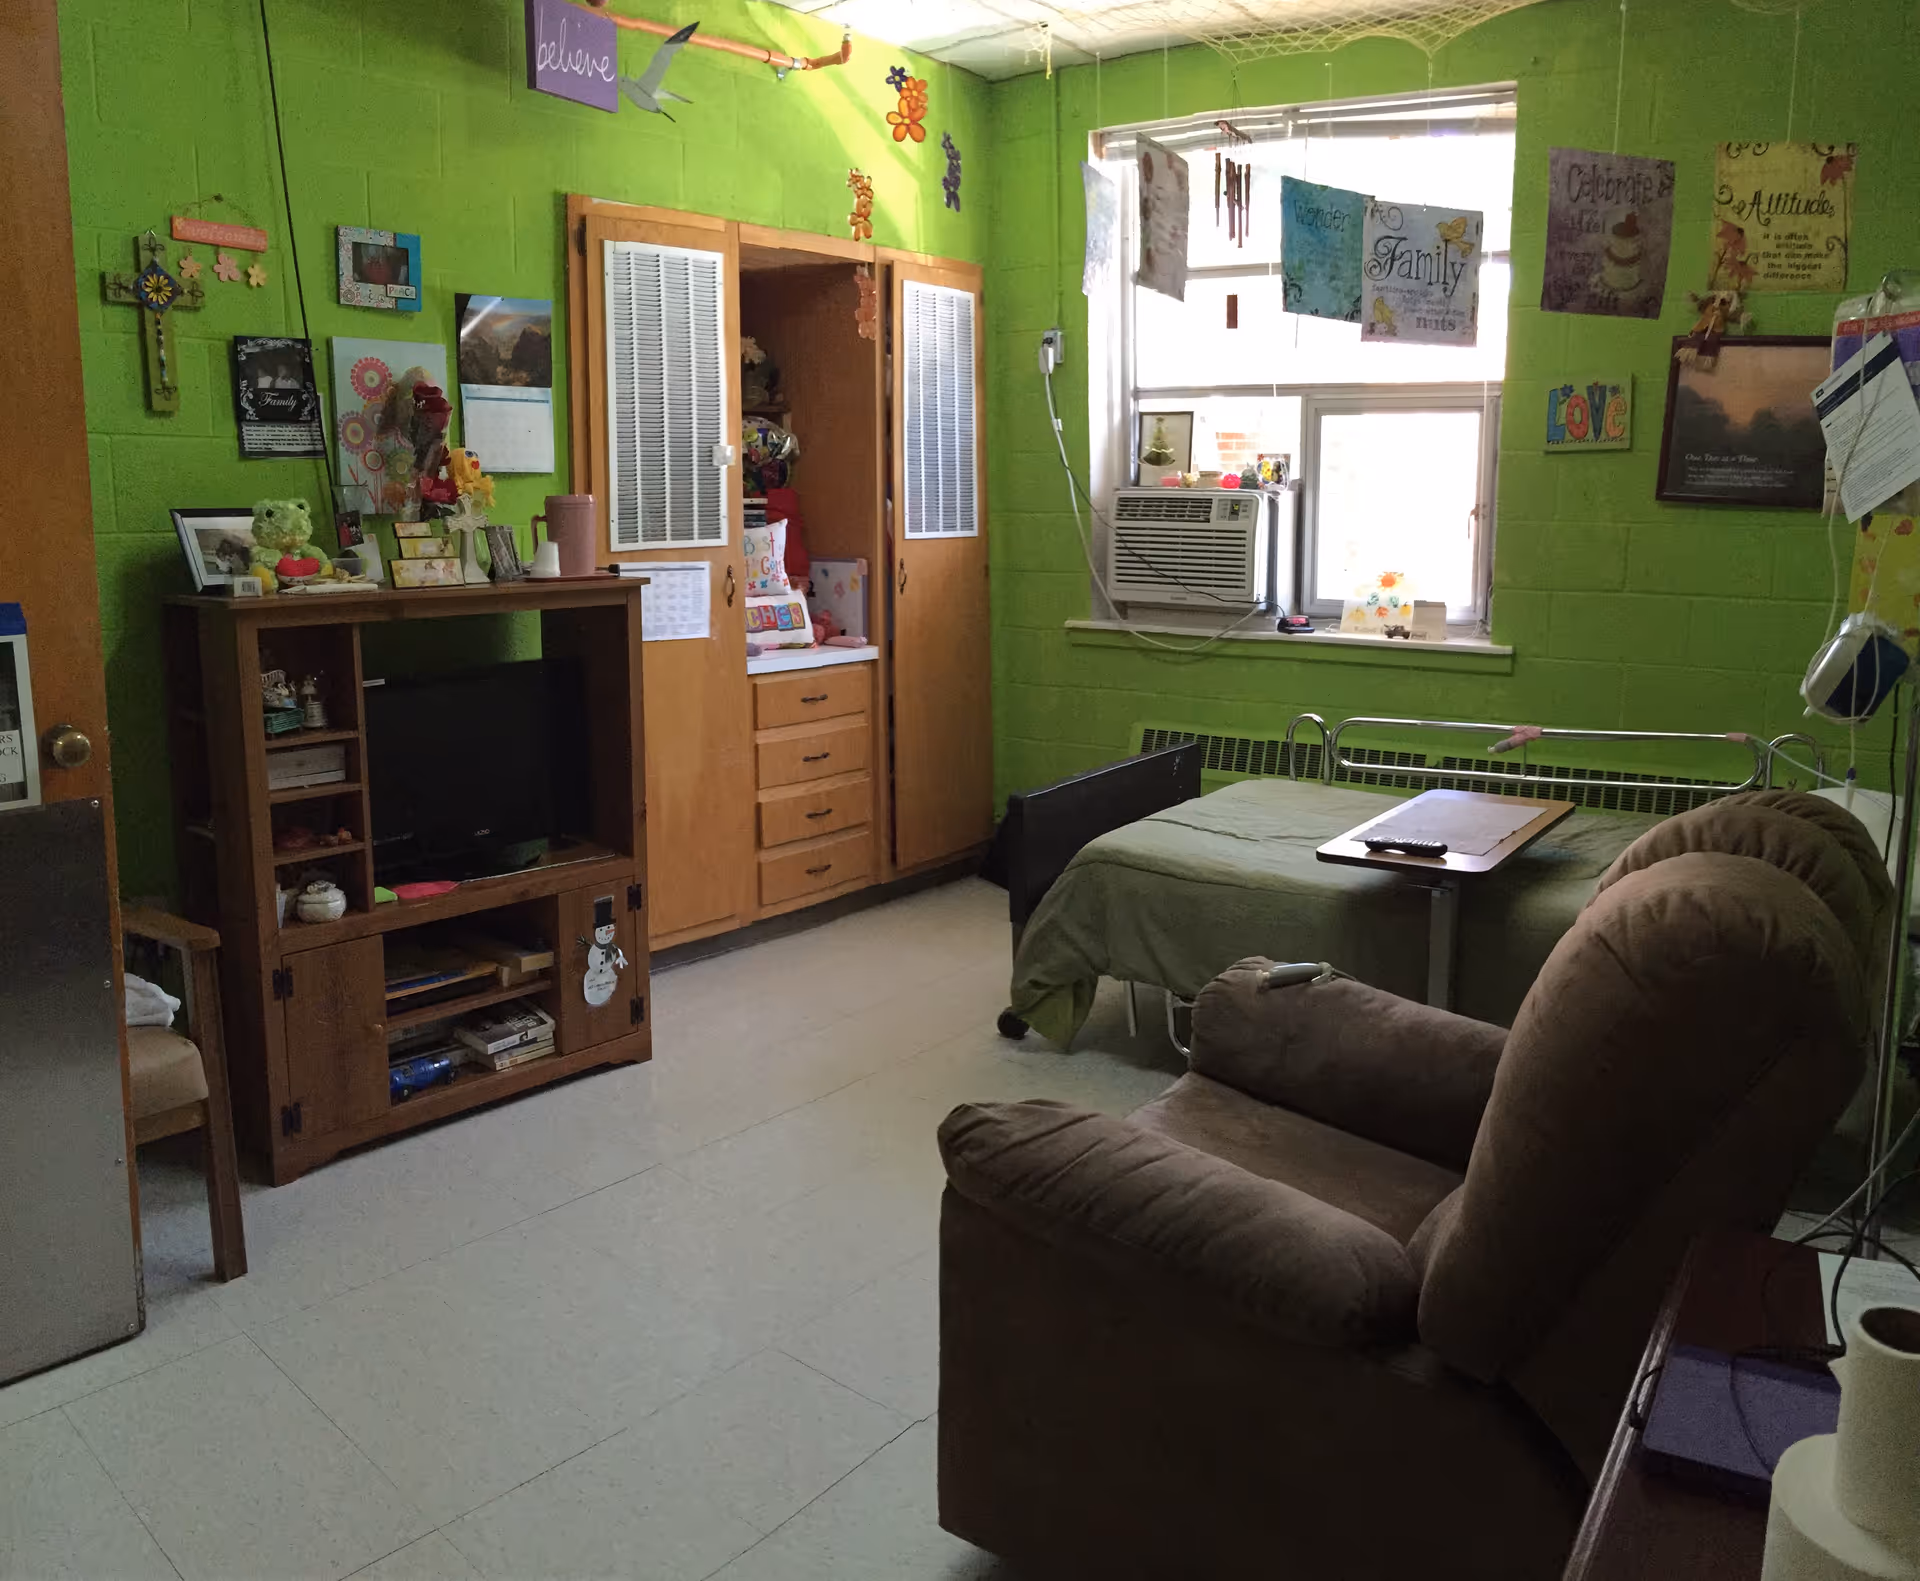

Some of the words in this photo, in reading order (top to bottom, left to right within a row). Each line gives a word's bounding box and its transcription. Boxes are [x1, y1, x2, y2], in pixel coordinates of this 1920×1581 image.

[537, 3, 616, 82] believe
[1567, 163, 1654, 205] Celebrate
[1735, 189, 1832, 226] Attitude
[1784, 232, 1809, 240] often
[1762, 251, 1782, 259] that
[1804, 251, 1829, 259] make
[1364, 235, 1467, 298] Family
[1787, 262, 1822, 271] biggest
[1763, 272, 1812, 280] difference
[1415, 317, 1457, 332] nuts
[258, 391, 298, 412] Family
